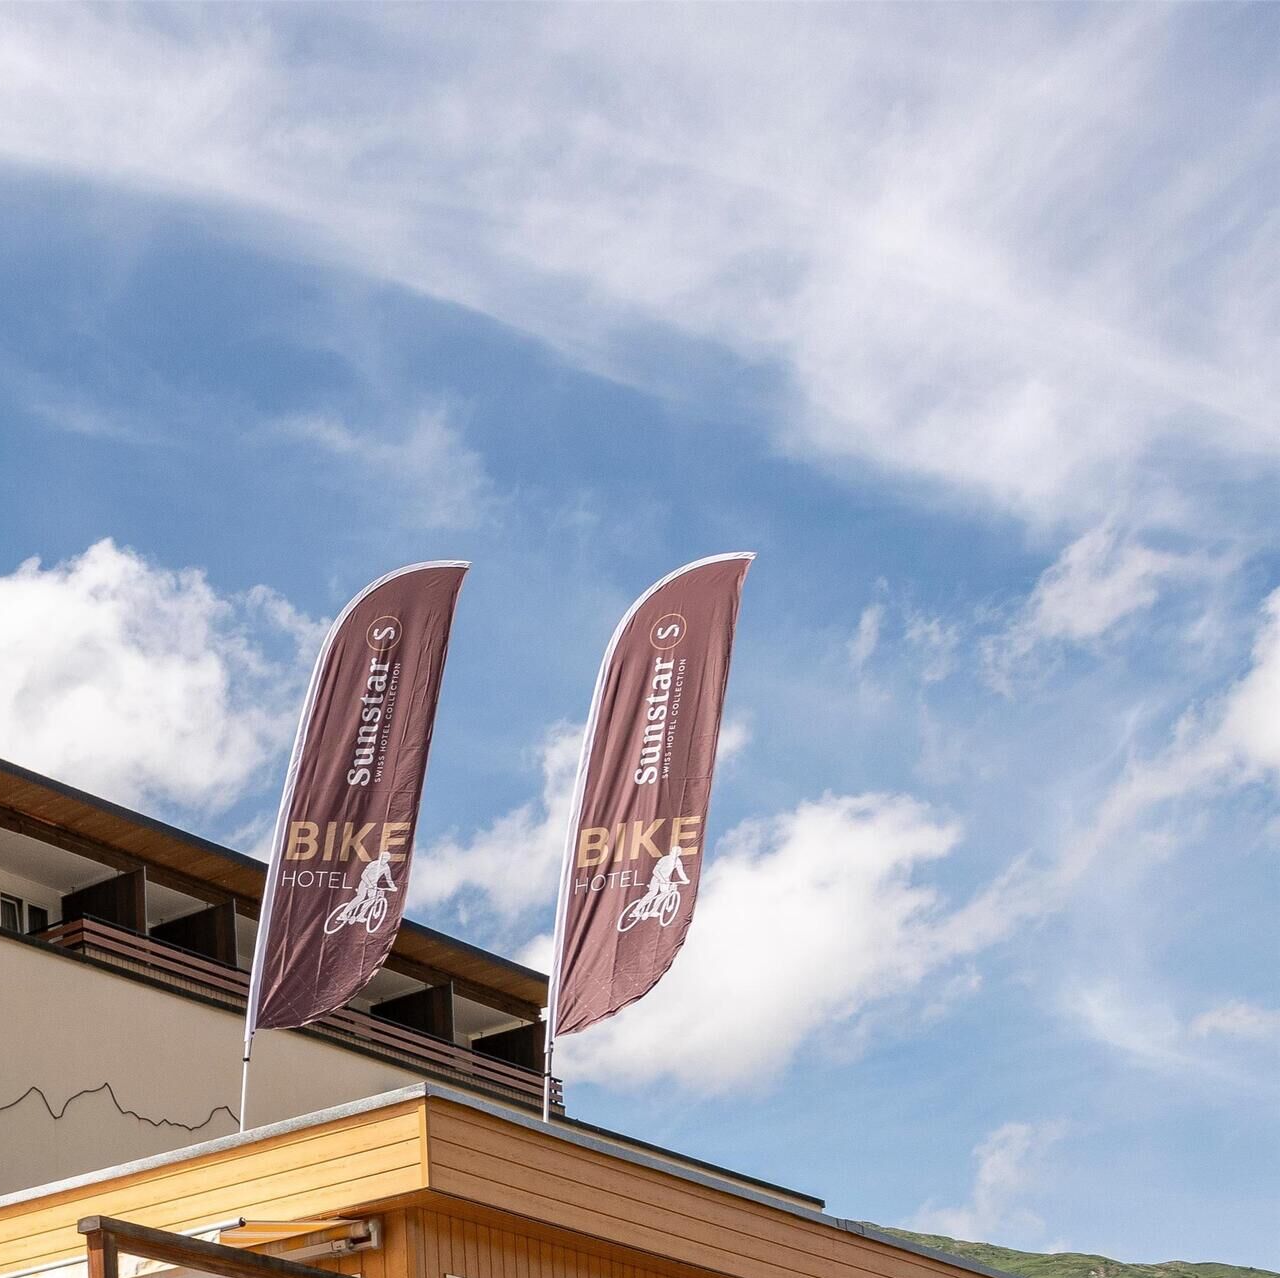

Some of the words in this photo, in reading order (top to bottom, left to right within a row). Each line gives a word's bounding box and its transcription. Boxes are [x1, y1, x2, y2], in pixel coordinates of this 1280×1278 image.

[385, 662, 401, 720] COLLECTION
[347, 657, 390, 787] Sunstar
[380, 723, 391, 752] HOTEL
[634, 657, 675, 785] Sunstar
[662, 752, 672, 779] SWISS
[667, 720, 677, 748] HOTEL
[672, 659, 687, 716] COLLECTION
[375, 755, 386, 783] SWISS
[285, 821, 411, 862] BIKE
[577, 816, 702, 869] BIKE
[281, 870, 353, 890] HOTEL
[574, 869, 645, 895] HOTEL
